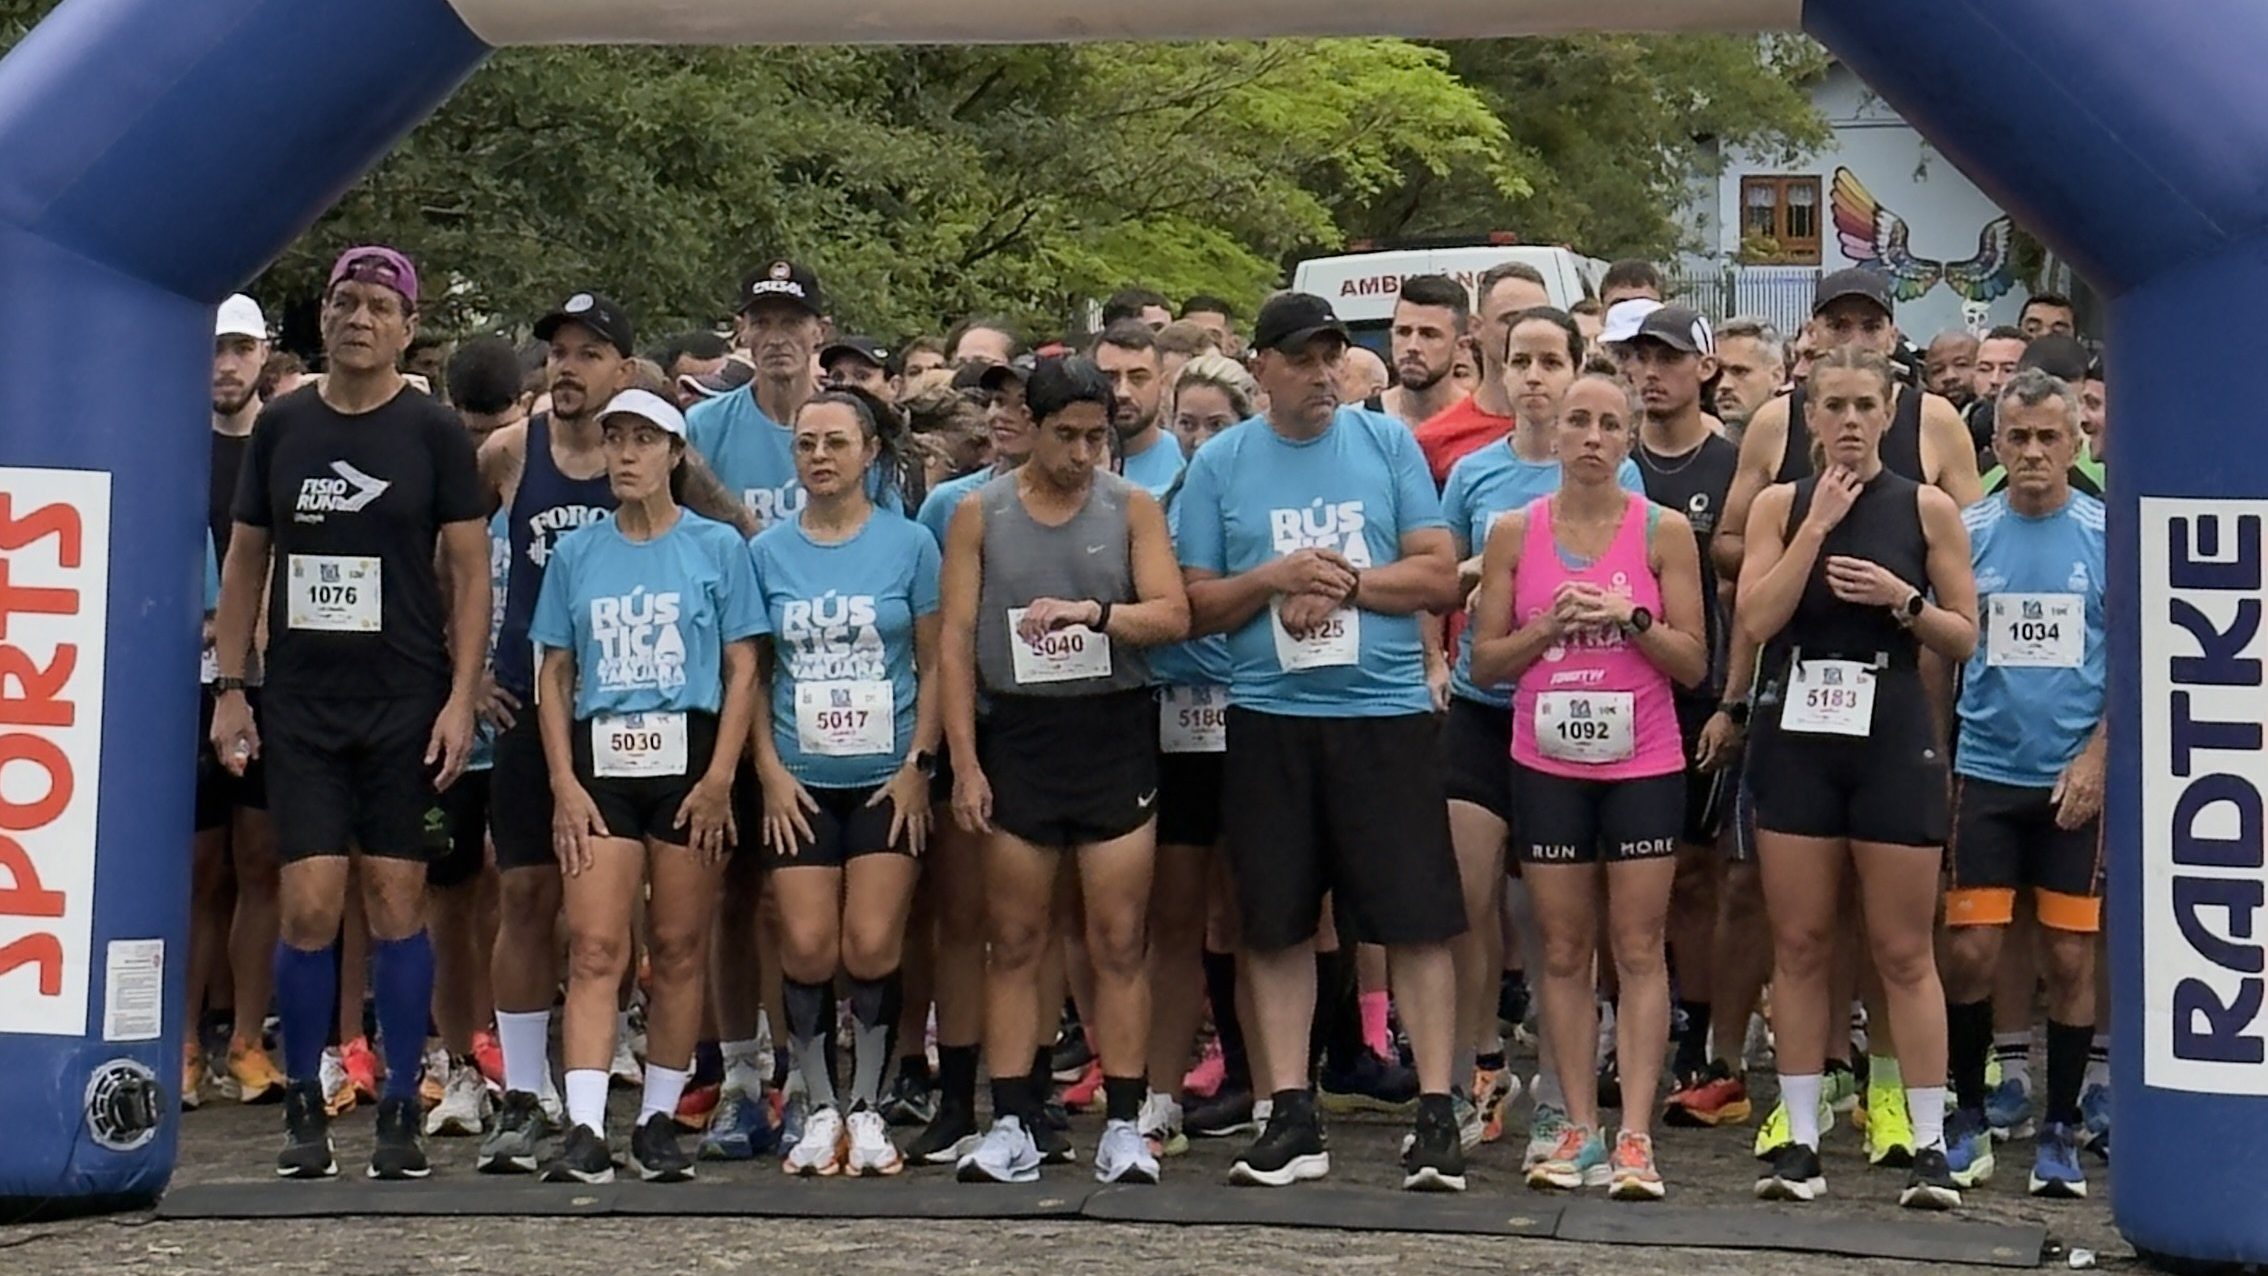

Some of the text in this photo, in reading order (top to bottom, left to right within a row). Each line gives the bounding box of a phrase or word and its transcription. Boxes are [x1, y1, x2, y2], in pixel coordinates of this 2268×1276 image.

[301, 478, 347, 495] FISIO
[296, 494, 334, 511] RUN
[744, 477, 808, 528] RÚ
[1270, 497, 1366, 541] RÚS
[310, 585, 358, 605] 1076
[591, 584, 681, 630] RÚS
[784, 588, 877, 632] RÚS
[2009, 622, 2059, 641] 1034
[593, 623, 687, 662] TICA
[1806, 688, 1857, 708] 5183
[816, 710, 868, 730] 5017
[1557, 720, 1609, 740] 1092
[611, 732, 661, 751] 5030
[2168, 514, 2265, 1065] RADTKE
[1532, 844, 1576, 859] RUN
